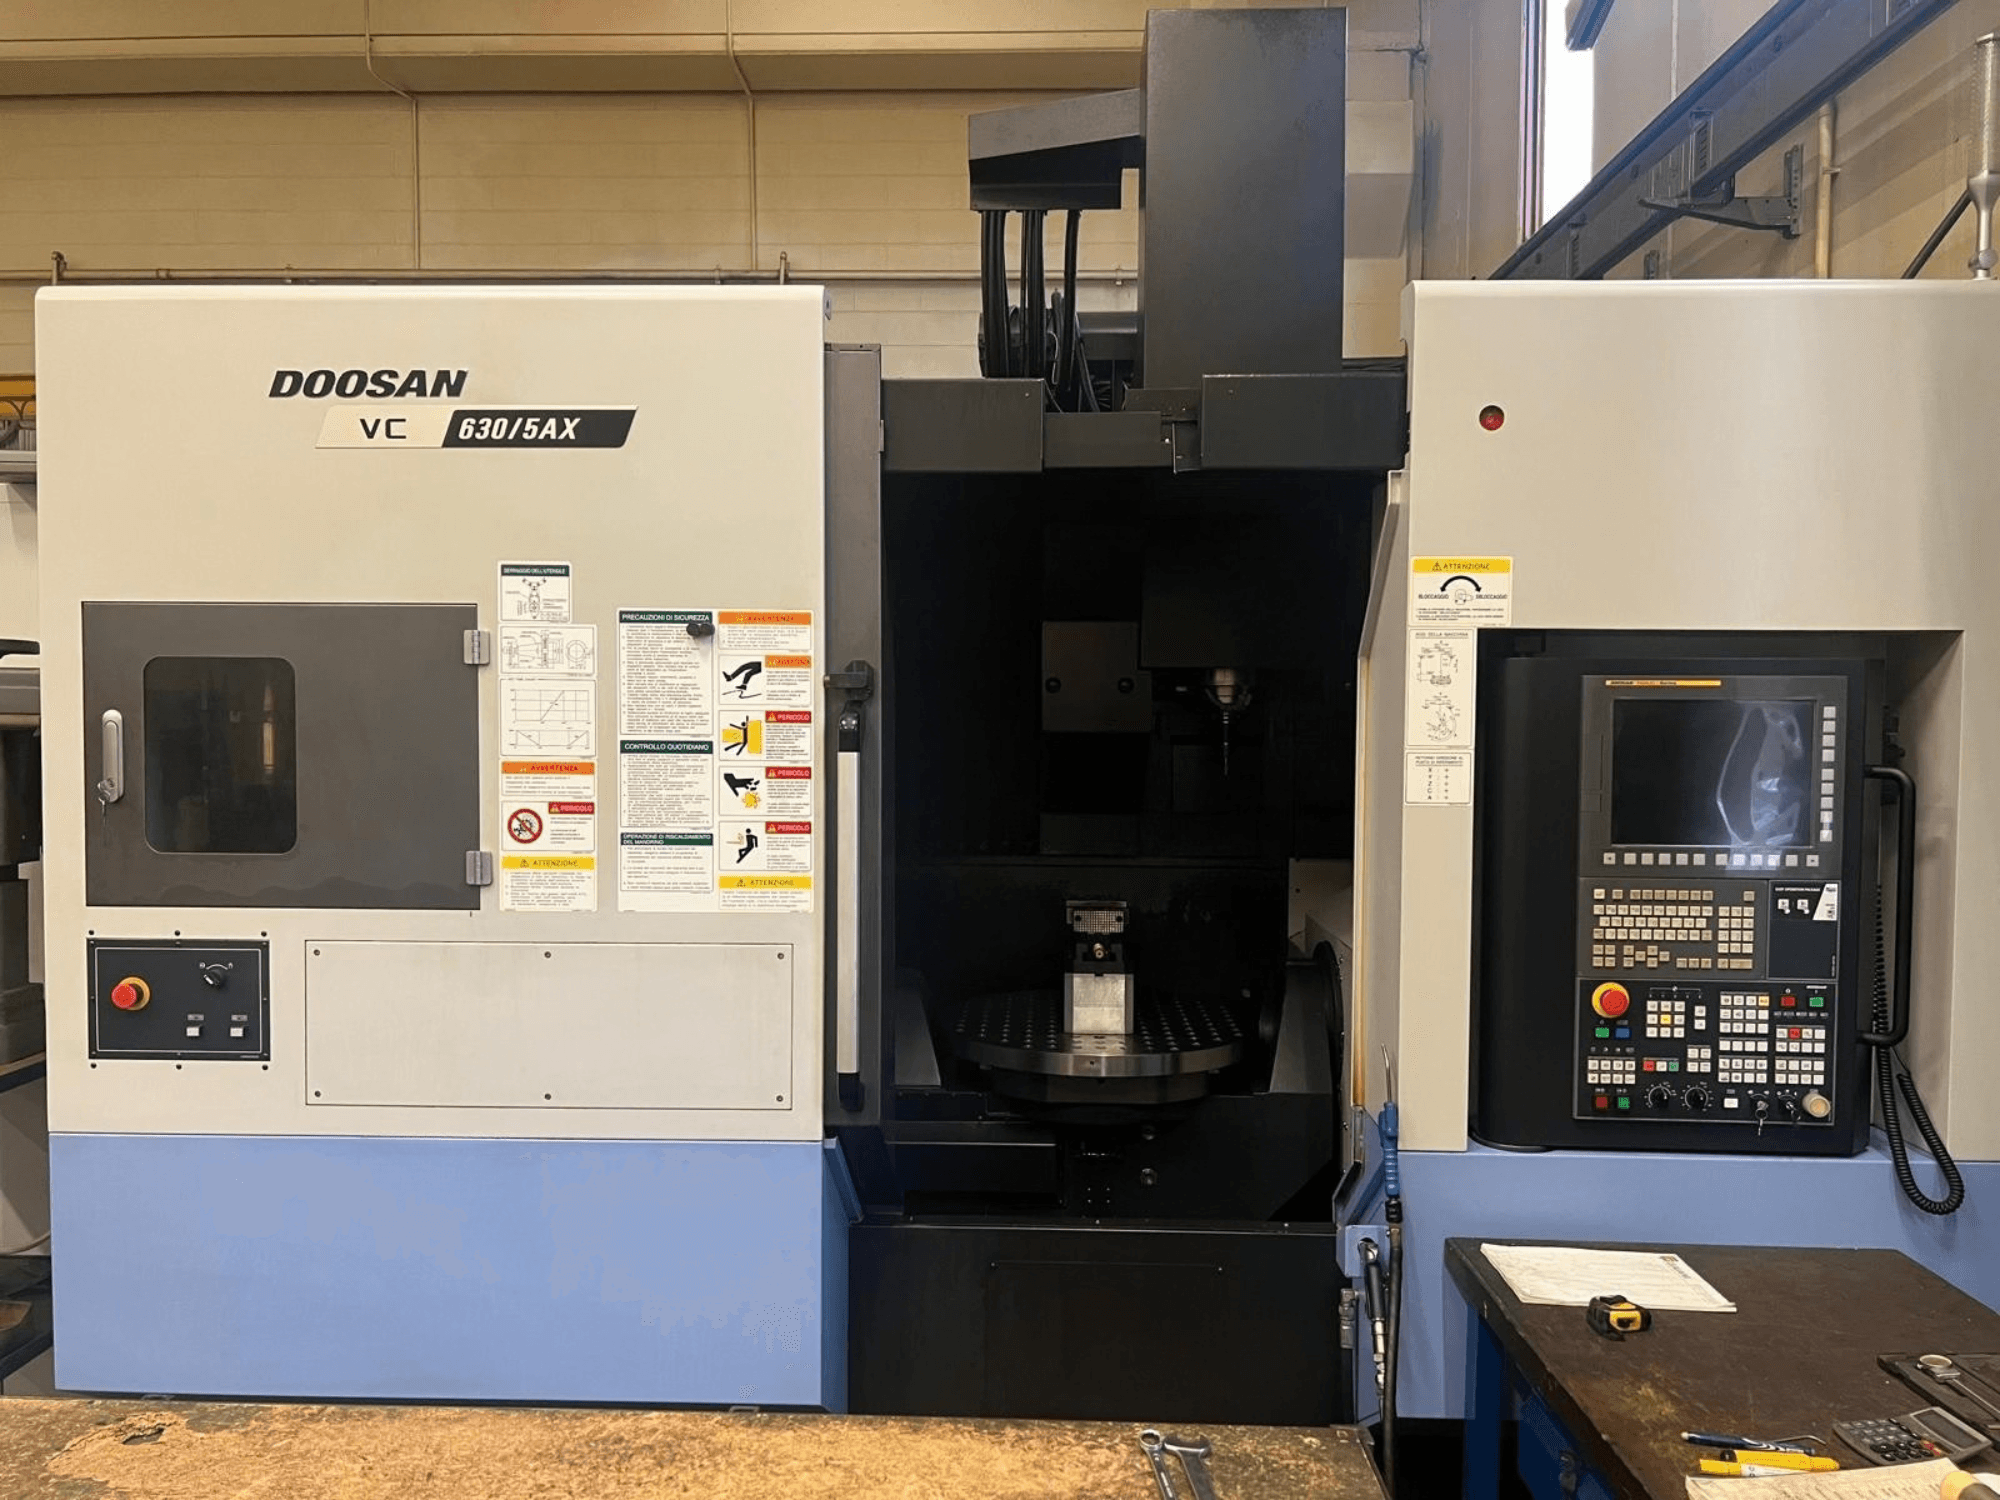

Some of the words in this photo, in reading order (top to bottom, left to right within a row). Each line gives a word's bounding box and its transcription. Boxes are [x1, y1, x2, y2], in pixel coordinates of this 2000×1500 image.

[269, 369, 467, 398] DOOSAN
[360, 418, 407, 439] VC
[458, 417, 581, 440] 630/5AX
[621, 613, 665, 621] PRECAUZIONI
[624, 743, 666, 751] CONTROLLO
[667, 743, 710, 751] QUOTIDIANO
